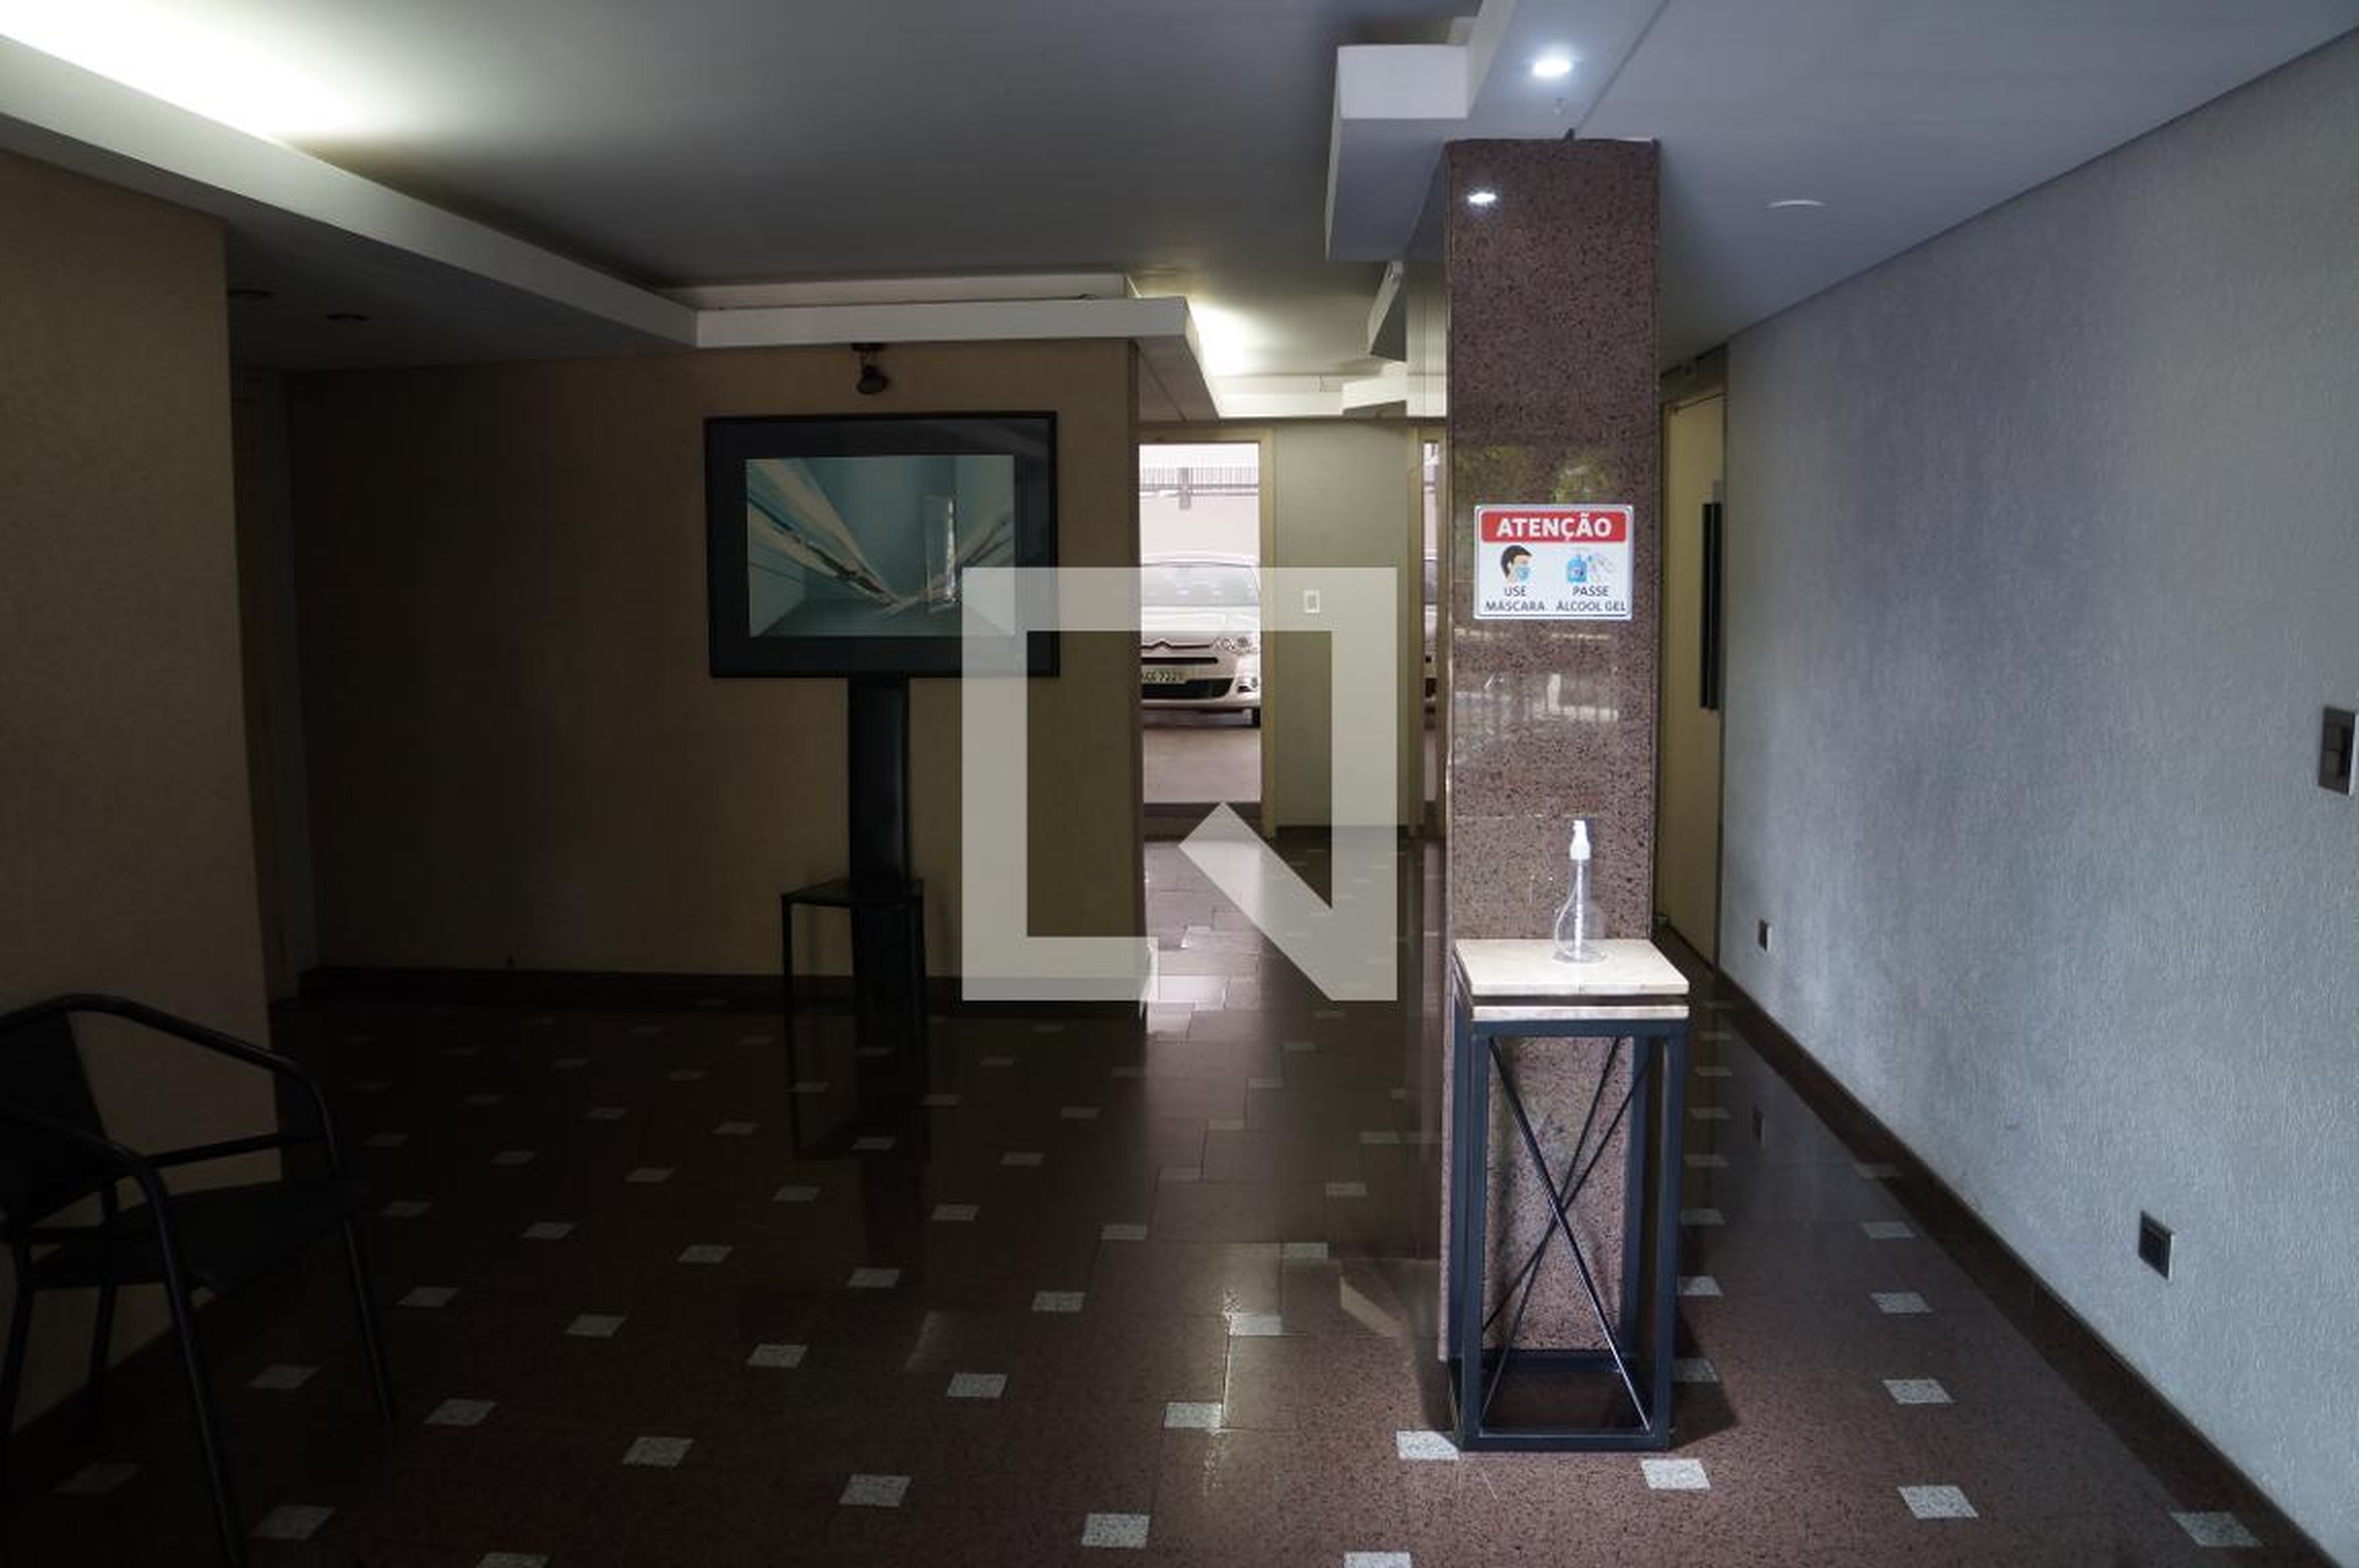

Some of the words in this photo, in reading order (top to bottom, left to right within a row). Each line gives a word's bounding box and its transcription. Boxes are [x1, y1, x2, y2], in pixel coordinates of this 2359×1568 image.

[1496, 512, 1613, 542] ATENÇÃO
[1504, 585, 1527, 597] USE
[1572, 585, 1610, 597] PASSE
[1605, 600, 1626, 612] GEL
